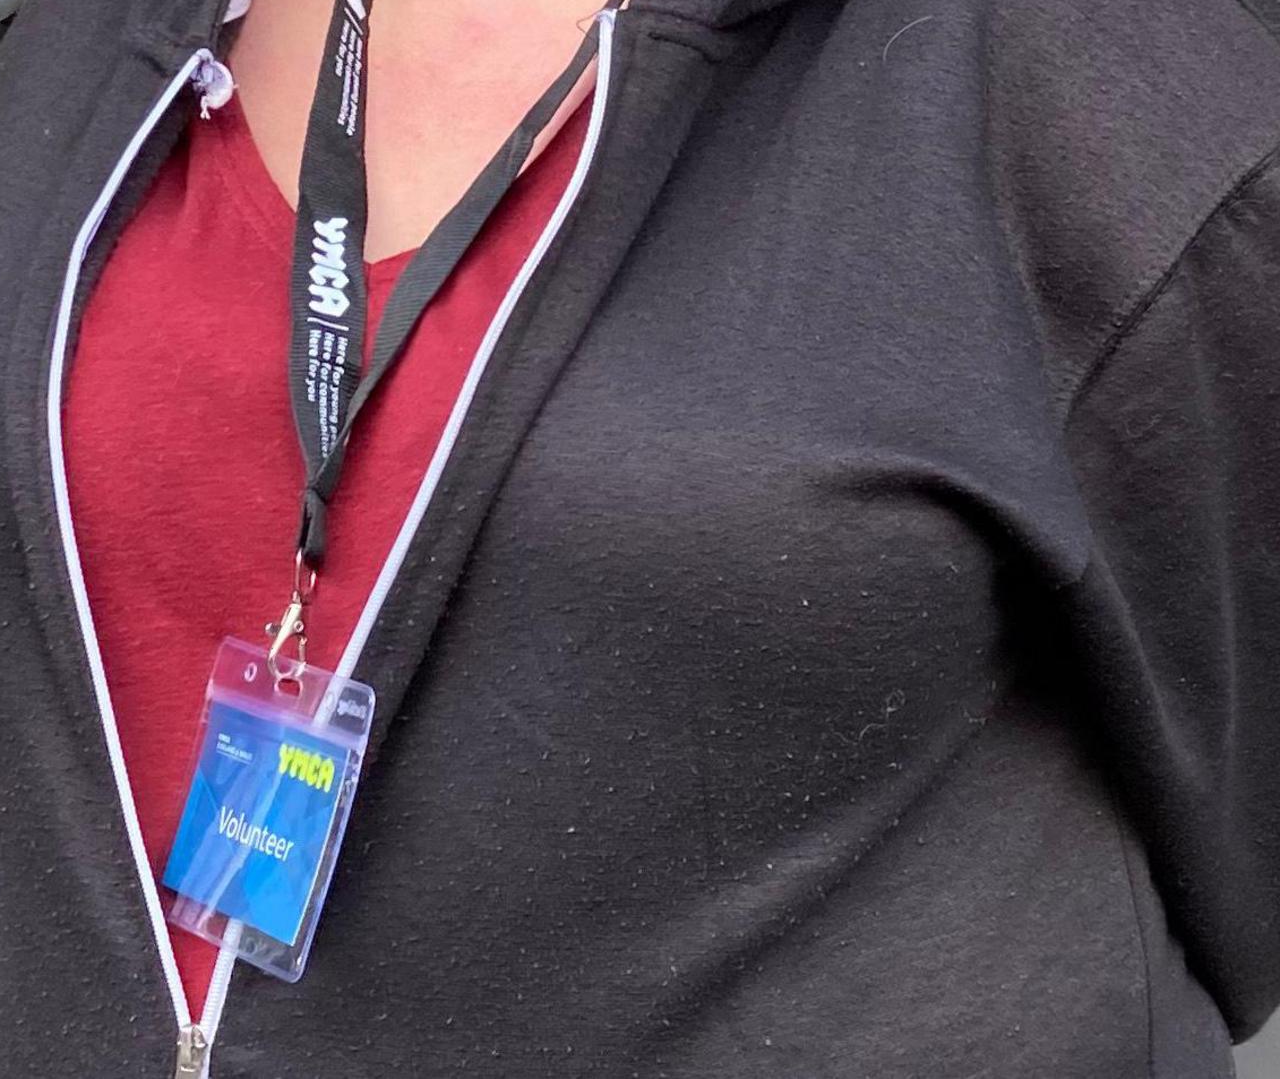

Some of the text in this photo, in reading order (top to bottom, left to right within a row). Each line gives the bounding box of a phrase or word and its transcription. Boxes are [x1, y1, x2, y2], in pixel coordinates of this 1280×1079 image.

[308, 217, 350, 318] YMCA
[304, 329, 323, 402] Here for you
[322, 331, 336, 360] Here
[336, 336, 349, 366] Here
[321, 361, 333, 381] for
[332, 366, 345, 386] for
[328, 384, 340, 424] young
[278, 743, 336, 793] YMCA
[218, 805, 295, 862] Volunteer
